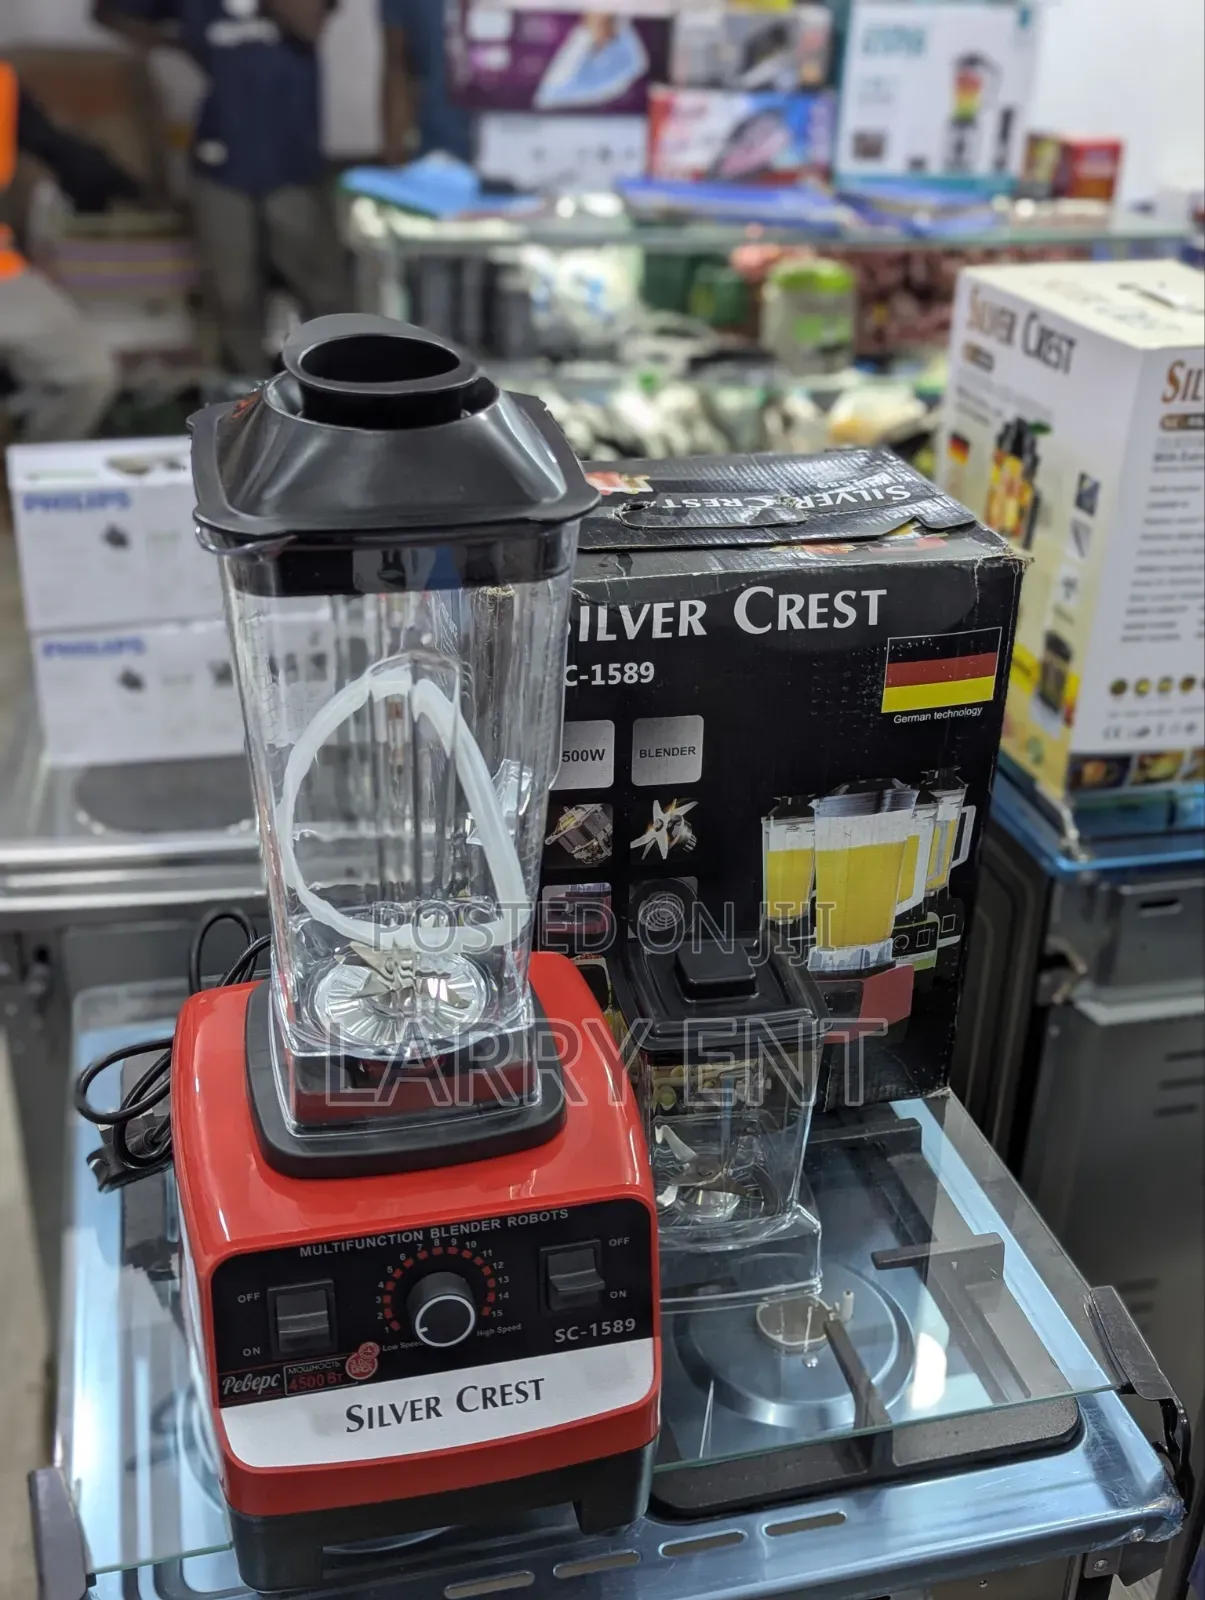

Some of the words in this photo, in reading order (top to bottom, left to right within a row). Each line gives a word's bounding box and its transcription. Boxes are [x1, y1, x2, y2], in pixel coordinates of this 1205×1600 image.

[795, 485, 911, 510] SILVER
[661, 496, 775, 511] CREST
[567, 600, 708, 642] ILVER
[733, 586, 887, 634] CREST
[564, 661, 655, 686] C-1589
[893, 713, 931, 724] German
[934, 707, 983, 720] technology
[561, 748, 606, 763] 500W
[639, 746, 697, 759] BLENDER
[299, 1229, 424, 1258] MULTIFUNCTION
[430, 1219, 501, 1240] BLENDER
[507, 1208, 569, 1228] ROBOTS
[433, 1238, 440, 1246] 8
[450, 1238, 457, 1246] 9
[465, 1240, 477, 1248] 10
[609, 1237, 630, 1247] OFF
[399, 1253, 406, 1261] 6
[386, 1266, 393, 1274] 5
[492, 1261, 504, 1270] 12
[498, 1275, 510, 1284] 13
[378, 1281, 384, 1289] 4
[237, 1292, 261, 1303] OFF
[498, 1291, 510, 1300] 14
[609, 1290, 627, 1299] ON
[375, 1296, 382, 1304] 3
[376, 1312, 383, 1320] 2
[491, 1309, 503, 1318] 15
[477, 1328, 495, 1337] High
[497, 1323, 522, 1335] Speed
[554, 1318, 636, 1343] SC-1589
[242, 1347, 261, 1357] ON
[382, 1342, 399, 1352] Low
[222, 1373, 281, 1395] Реверс
[288, 1373, 326, 1391] 4500
[346, 1396, 443, 1433] SILVER
[455, 1377, 545, 1413] CREST
